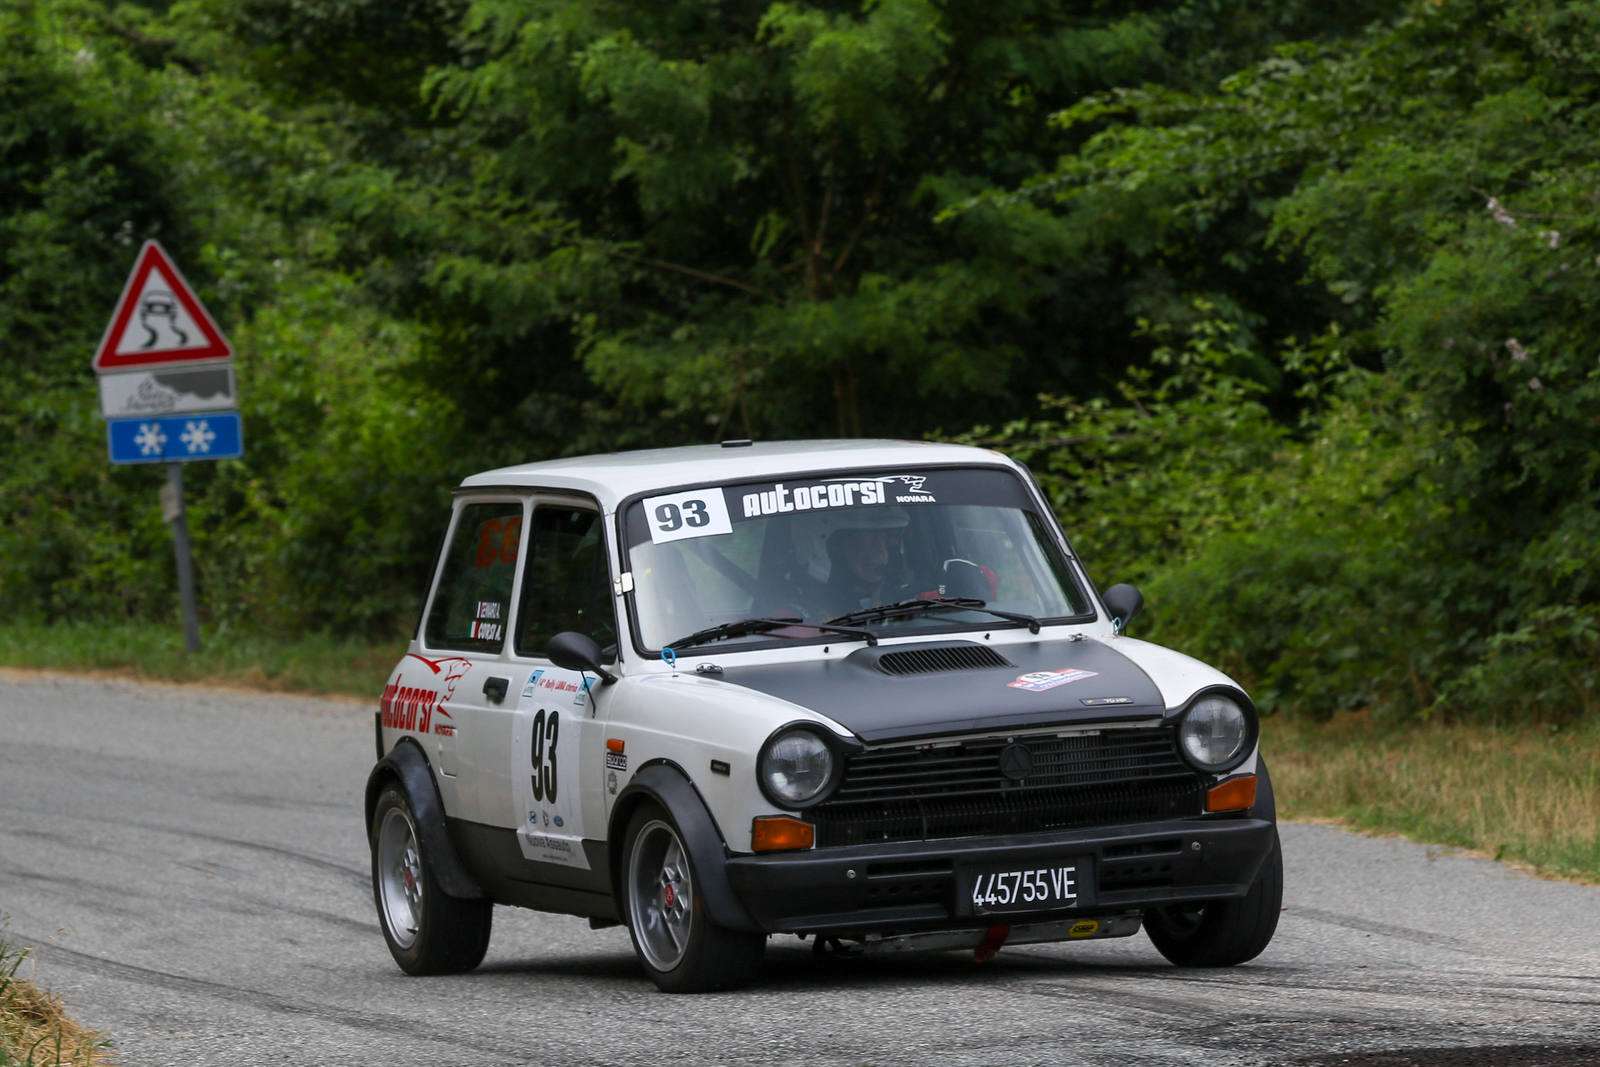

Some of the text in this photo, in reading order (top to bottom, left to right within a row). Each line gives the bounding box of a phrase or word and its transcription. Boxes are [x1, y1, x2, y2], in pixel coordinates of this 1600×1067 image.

[896, 495, 936, 503] NOVARA
[654, 499, 711, 532] 93
[531, 708, 559, 804] 93
[1073, 924, 1096, 933] OMP
